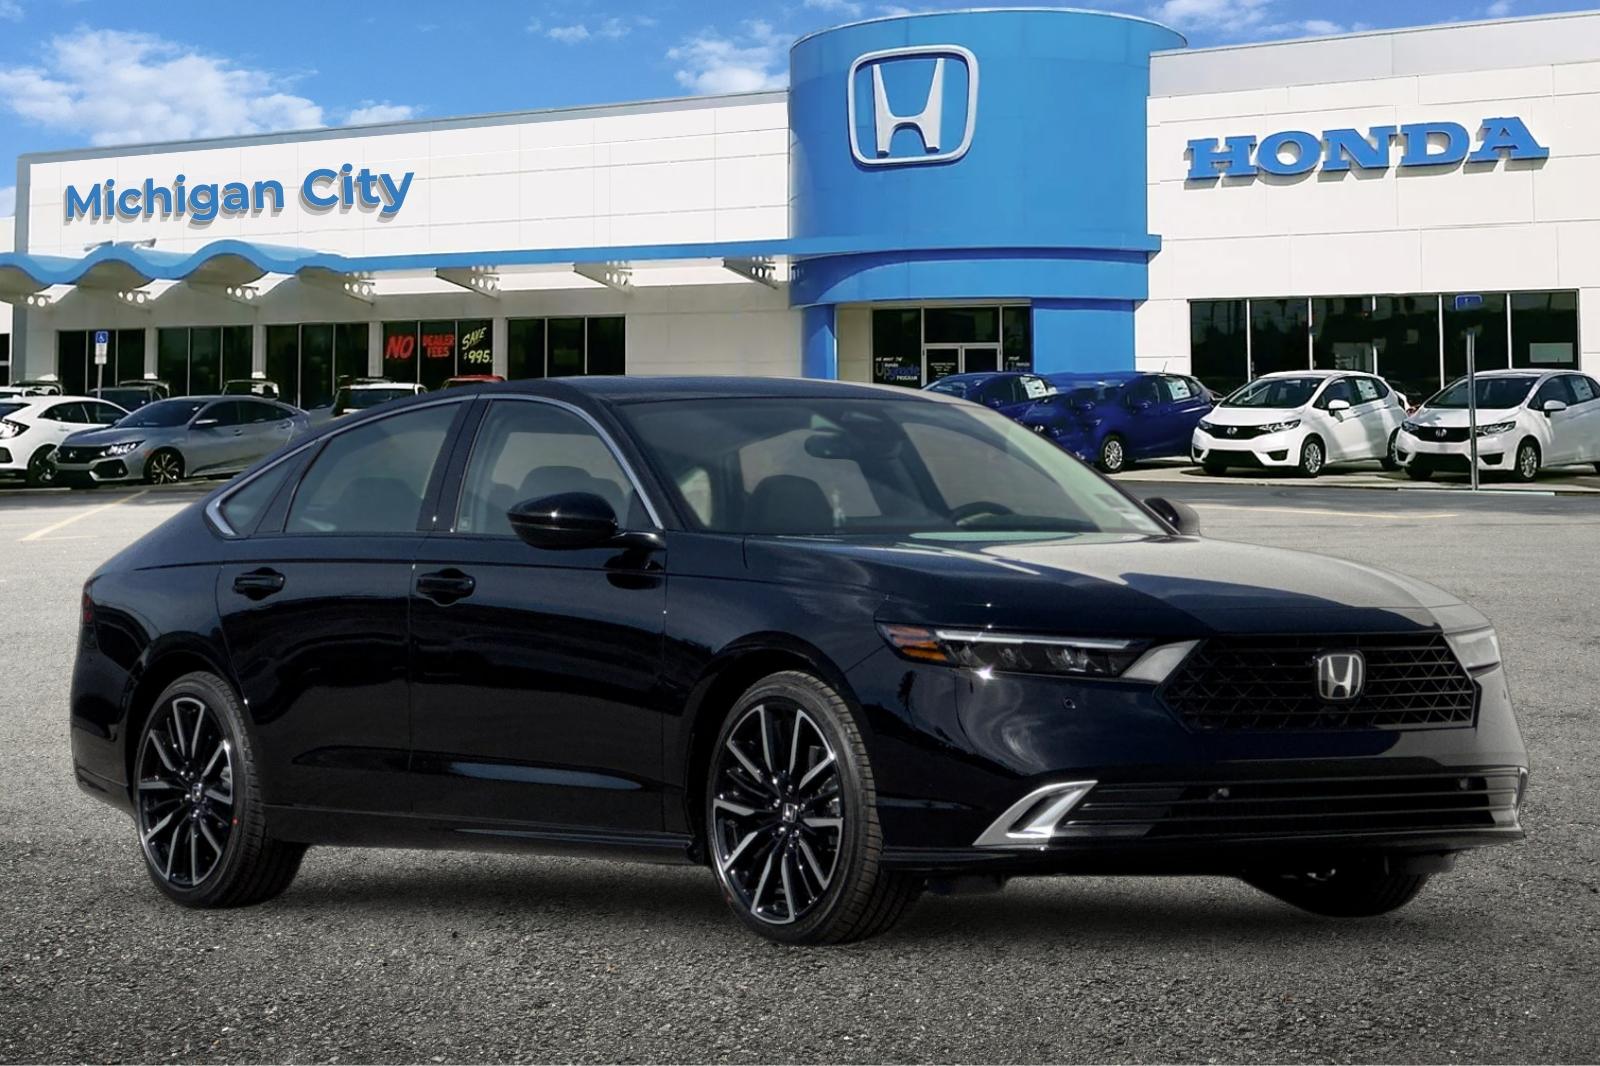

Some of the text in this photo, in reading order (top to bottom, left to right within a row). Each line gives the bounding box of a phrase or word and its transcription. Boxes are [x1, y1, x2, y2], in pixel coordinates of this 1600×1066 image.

[1186, 116, 1550, 181] HONDA
[65, 163, 415, 222] Michigan City
[385, 335, 415, 359] NO
[462, 327, 487, 350] SAVE
